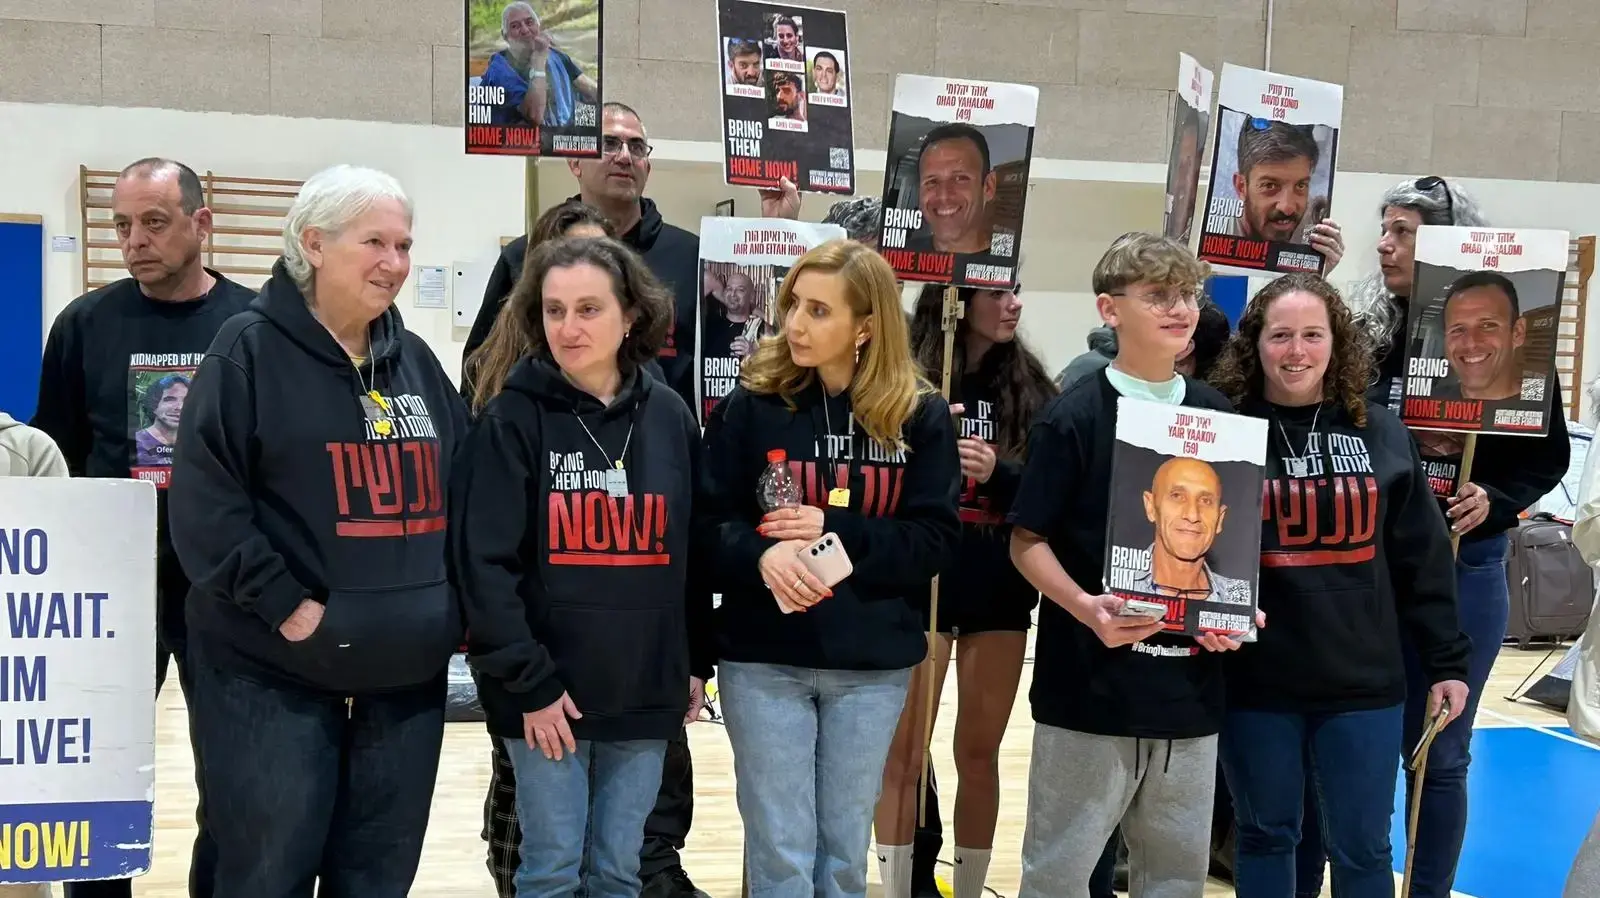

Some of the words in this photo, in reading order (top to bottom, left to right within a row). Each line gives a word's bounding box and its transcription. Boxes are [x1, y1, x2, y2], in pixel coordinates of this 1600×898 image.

[468, 86, 505, 105] BRING
[936, 95, 956, 107] OHAD
[958, 97, 994, 110] YAHALOMI
[1261, 94, 1279, 106] DAVID
[468, 105, 492, 124] HIM
[955, 108, 971, 121] (49)
[467, 127, 502, 145] HOME
[506, 127, 540, 147] NOW!
[728, 119, 762, 139] BRING
[729, 137, 760, 157] THEM
[730, 157, 762, 177] HOME
[765, 161, 798, 181] NOW!
[1210, 197, 1244, 217] BRING
[884, 208, 922, 229] BRING
[1206, 215, 1229, 234] HIM
[882, 228, 907, 248] HIM
[1203, 235, 1234, 257] HOME
[1236, 239, 1269, 261] NOW!
[1461, 242, 1482, 254] OHAD
[749, 243, 765, 255] AND
[766, 243, 787, 255] EITAN
[883, 249, 917, 271] HOME
[918, 252, 954, 274] NOW!
[1483, 255, 1499, 269] (49)
[130, 353, 178, 366] KIDNAPPED
[181, 353, 192, 366] BY
[704, 357, 740, 377] BRING
[1408, 357, 1449, 378] BRING
[704, 377, 736, 397] THEM
[1406, 377, 1433, 397] HIM
[1404, 398, 1440, 418] HOME
[1444, 401, 1482, 421] NOW!
[1168, 425, 1185, 439] YAIR
[1187, 428, 1217, 443] YAAKOV
[1182, 440, 1199, 456] (59)
[549, 450, 584, 472] BRING
[1331, 453, 1374, 473] אותם
[1428, 461, 1457, 479] OHAD
[139, 471, 165, 484] BRING
[326, 441, 442, 515] עכשיו
[583, 469, 607, 490] HOM
[1428, 477, 1452, 495] OW!
[1262, 476, 1378, 546] עכשי
[548, 491, 666, 553] NOW!
[0, 528, 48, 576] NO
[1112, 545, 1152, 571] BRING
[1110, 567, 1135, 591] HIM
[7, 592, 115, 639] WAIT.
[1199, 618, 1226, 629] FAMILIES
[1227, 621, 1250, 632] FORUM
[0, 656, 46, 702] IM
[0, 718, 91, 765] LIVE!
